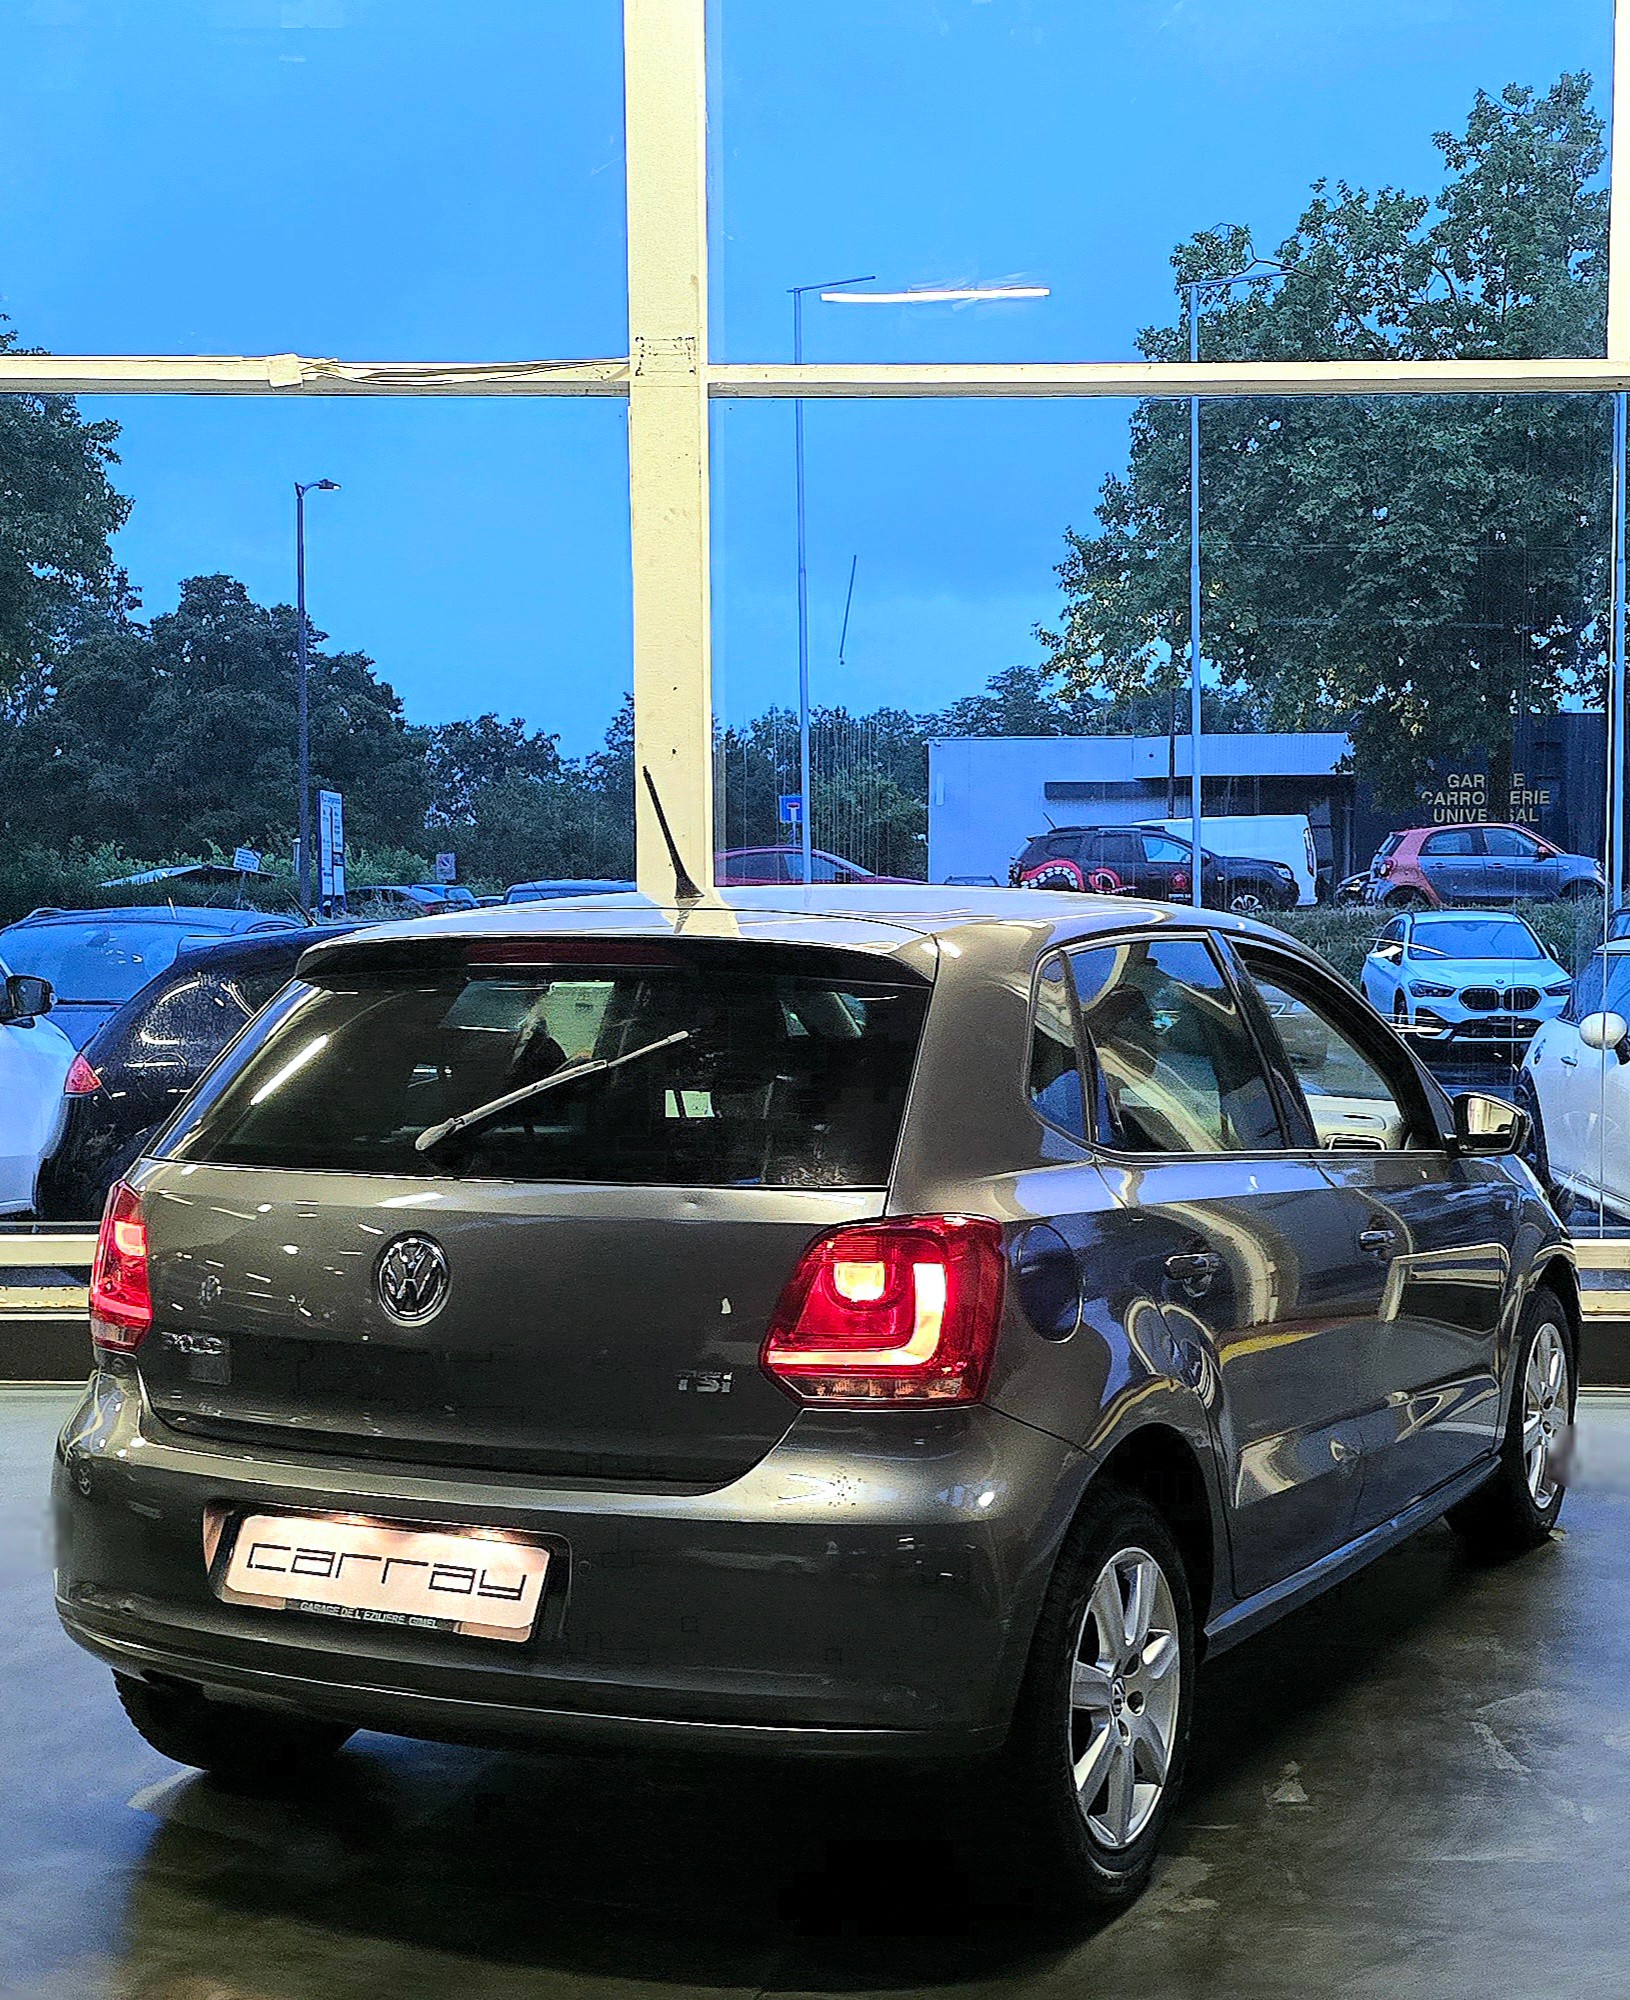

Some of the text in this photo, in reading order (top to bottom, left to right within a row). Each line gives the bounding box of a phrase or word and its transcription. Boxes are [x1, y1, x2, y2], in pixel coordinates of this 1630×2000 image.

[1447, 773, 1525, 788] GARE
[1421, 790, 1550, 806] CARROERIE
[1433, 808, 1539, 823] UNIVEAL
[247, 1543, 527, 1601] carray
[341, 1607, 354, 1619] DE
